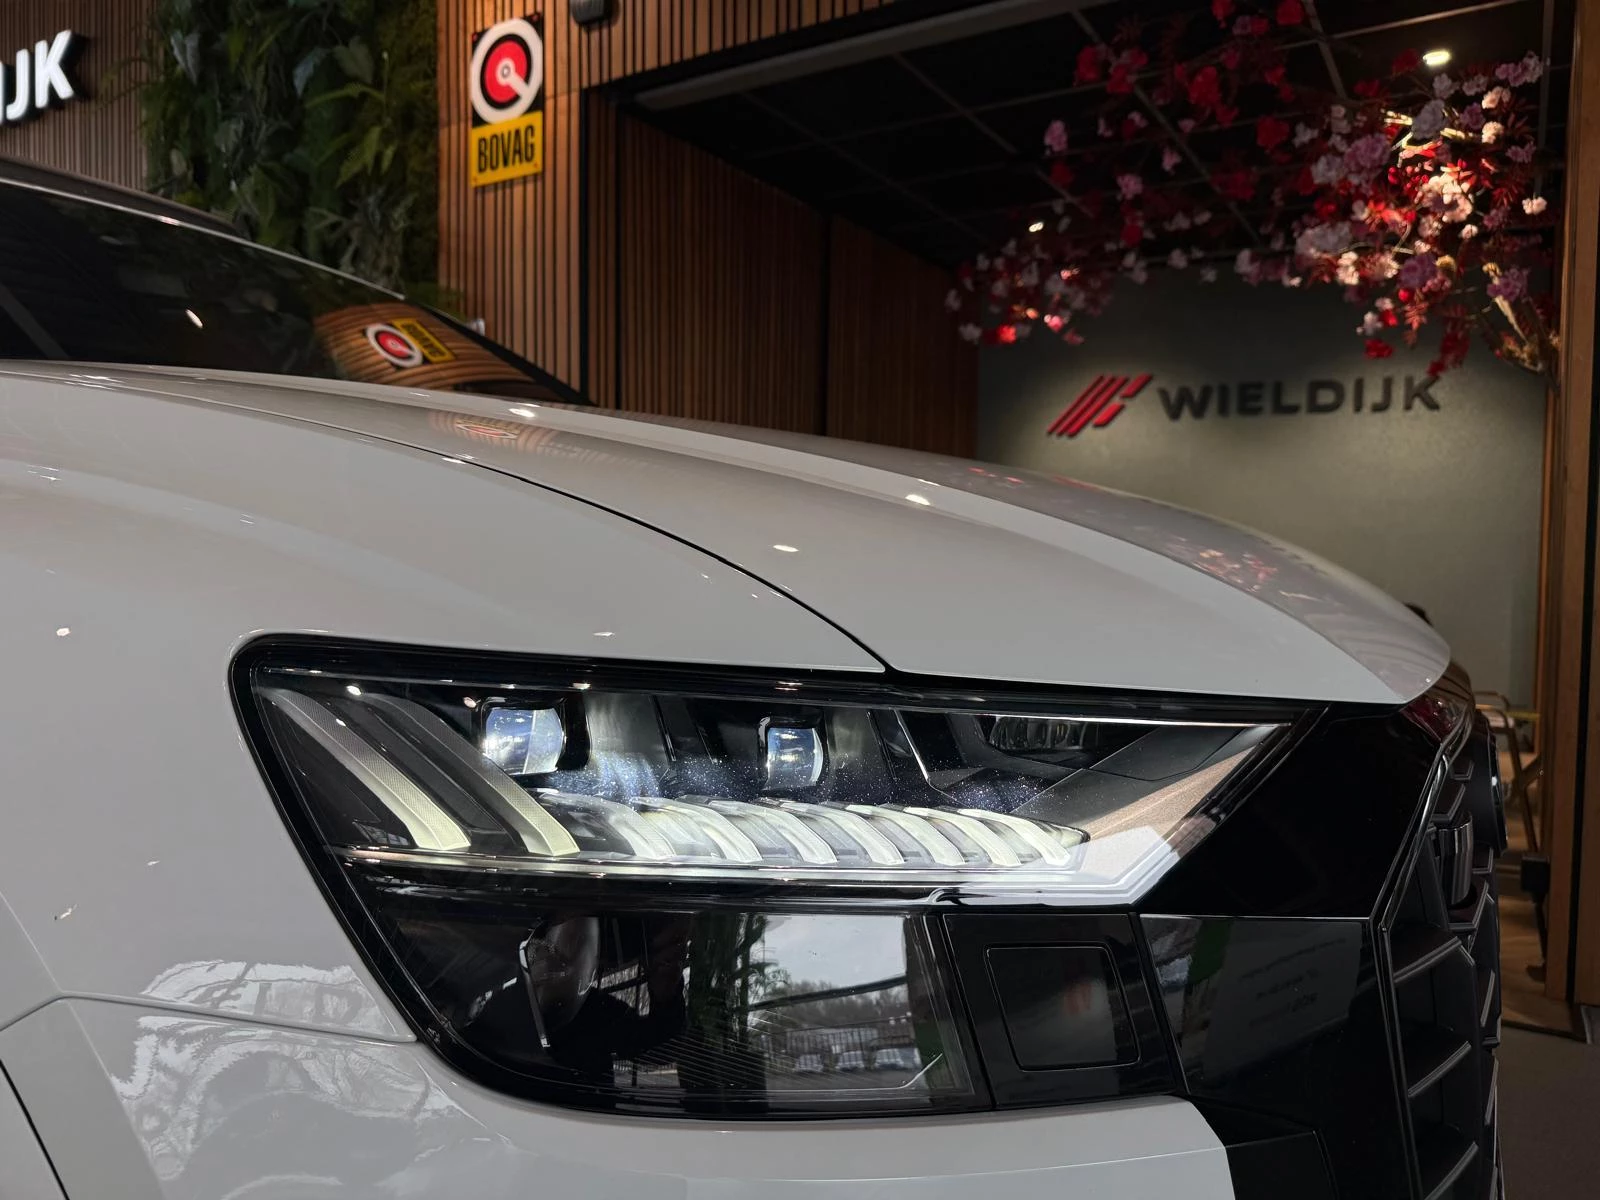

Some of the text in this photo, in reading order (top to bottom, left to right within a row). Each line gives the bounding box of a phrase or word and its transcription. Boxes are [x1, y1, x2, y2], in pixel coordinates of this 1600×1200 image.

[0, 29, 74, 124] JK
[477, 125, 535, 173] BOVAG
[1159, 376, 1440, 420] WIELDIJK
